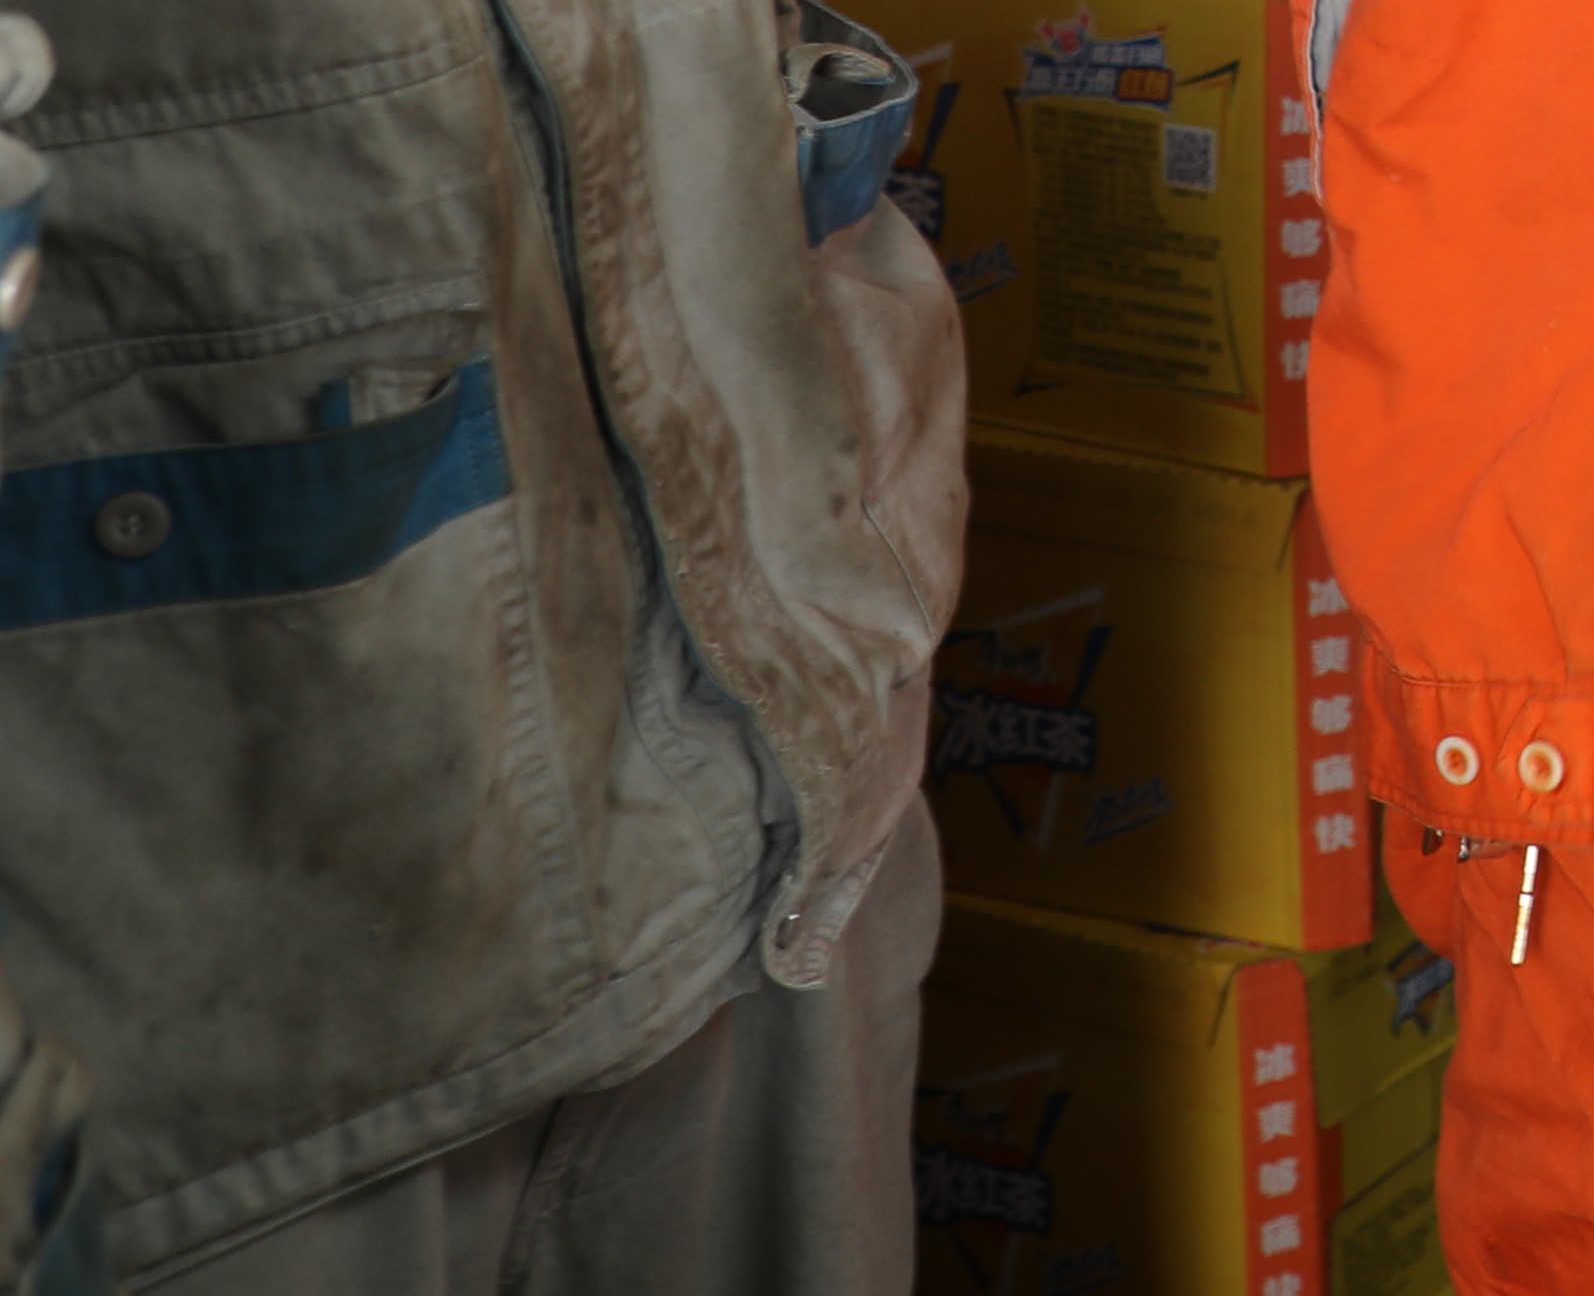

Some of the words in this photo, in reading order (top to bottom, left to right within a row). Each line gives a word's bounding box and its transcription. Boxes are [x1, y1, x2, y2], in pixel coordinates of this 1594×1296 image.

[936, 684, 1097, 787] 冰红茶
[1308, 578, 1361, 853] 冰爽够痛快
